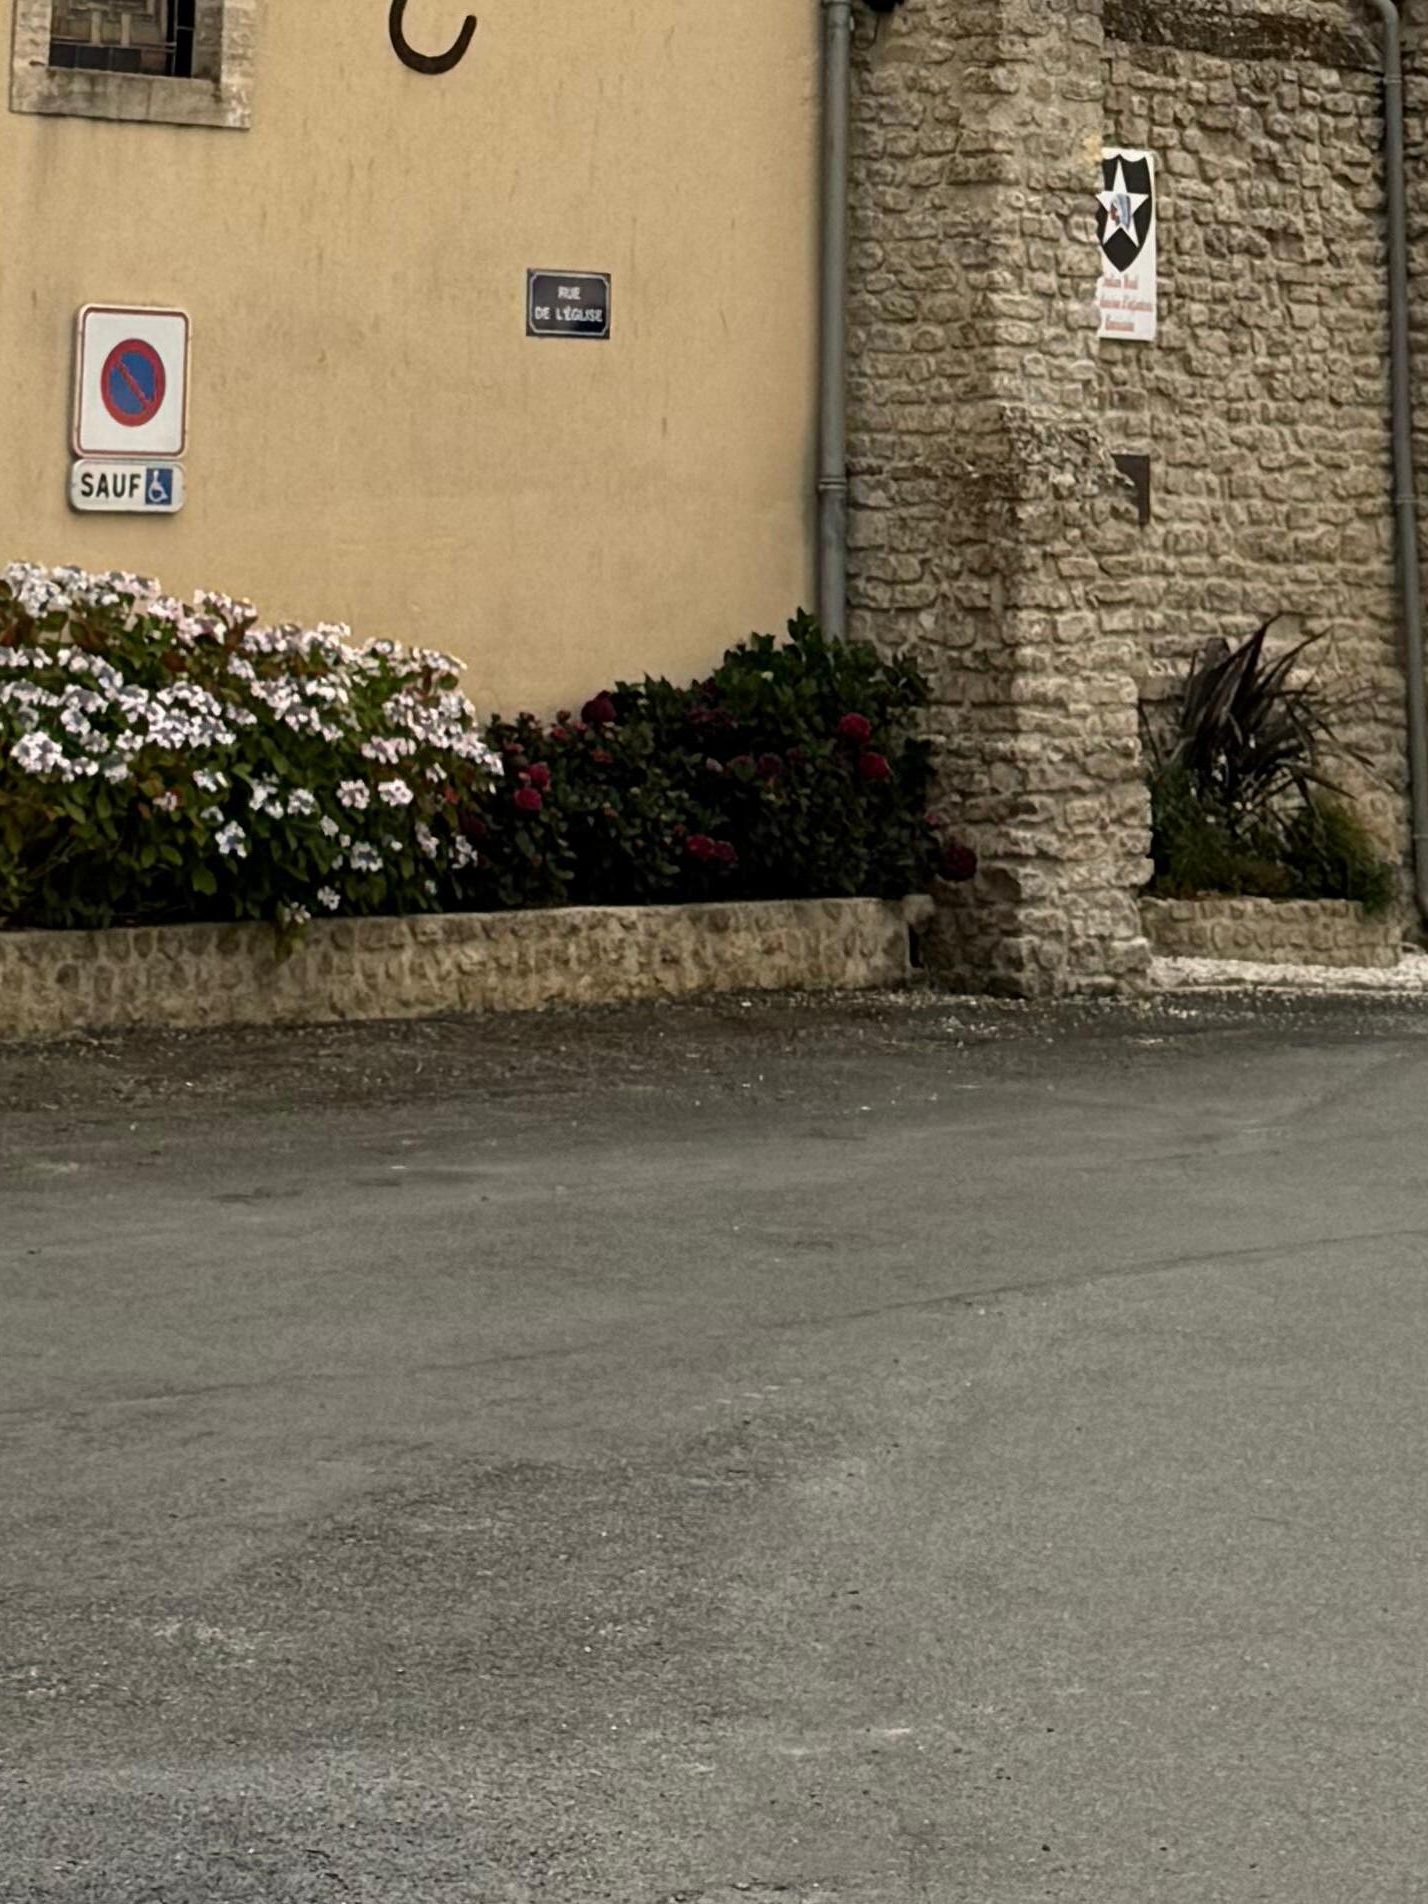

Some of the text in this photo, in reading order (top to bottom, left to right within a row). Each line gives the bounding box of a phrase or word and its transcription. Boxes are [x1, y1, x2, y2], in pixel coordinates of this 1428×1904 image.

[557, 286, 581, 300] RUE
[534, 306, 551, 320] DE
[80, 472, 142, 498] SAUF
